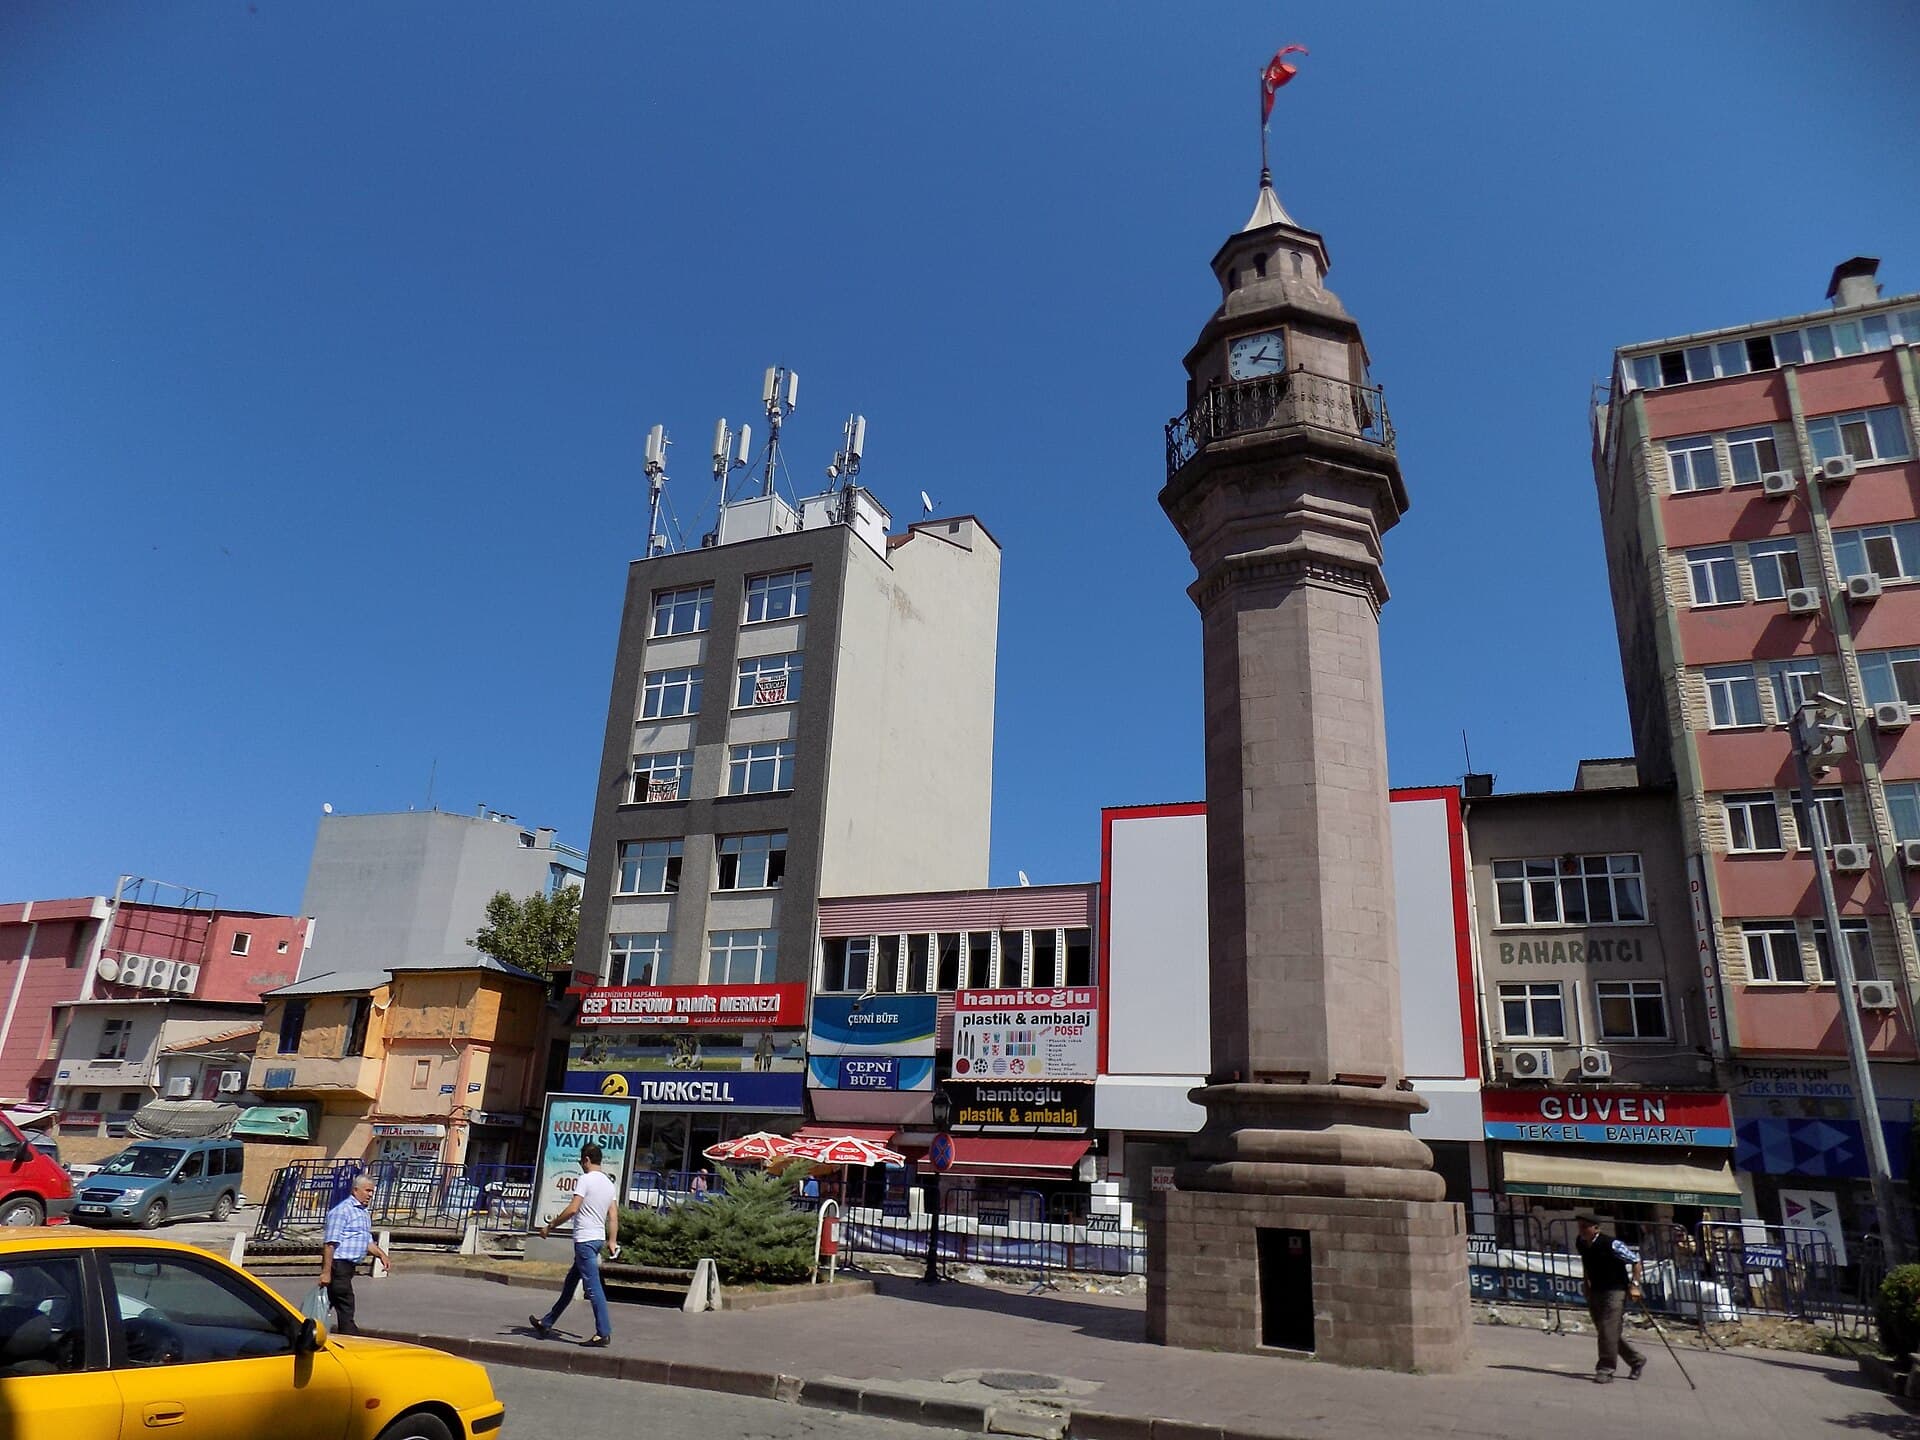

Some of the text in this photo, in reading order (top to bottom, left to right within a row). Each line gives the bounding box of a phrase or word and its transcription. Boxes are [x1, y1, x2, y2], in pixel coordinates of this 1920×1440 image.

[1500, 939, 1643, 965] BAHARATCI
[582, 998, 608, 1014] CEP
[676, 995, 716, 1013] TAMİR
[720, 994, 780, 1012] MERKEZİ
[963, 989, 1090, 1008] hamitoğlu
[1704, 966, 1721, 1040] OTEL
[848, 1012, 899, 1026] ÇEPNİ BÜFE
[963, 1012, 1090, 1027] plastik & ambalaj
[846, 1060, 892, 1074] ÇEPNİ
[850, 1074, 887, 1086] BÜFE
[641, 1081, 734, 1102] TURKCELL
[976, 1087, 1062, 1106] hamitoğlu
[571, 1108, 611, 1122] İYİLİK
[1540, 1093, 1666, 1122] GÜVEN
[959, 1107, 1077, 1127] plastik & ambalaj
[554, 1121, 625, 1135] KURBANLA
[1516, 1125, 1697, 1143] TEK-EL BAHARAT
[400, 1183, 430, 1192] ZABITA
[1087, 1220, 1119, 1231] ZABITA
[1745, 1255, 1783, 1267] ZABITA
